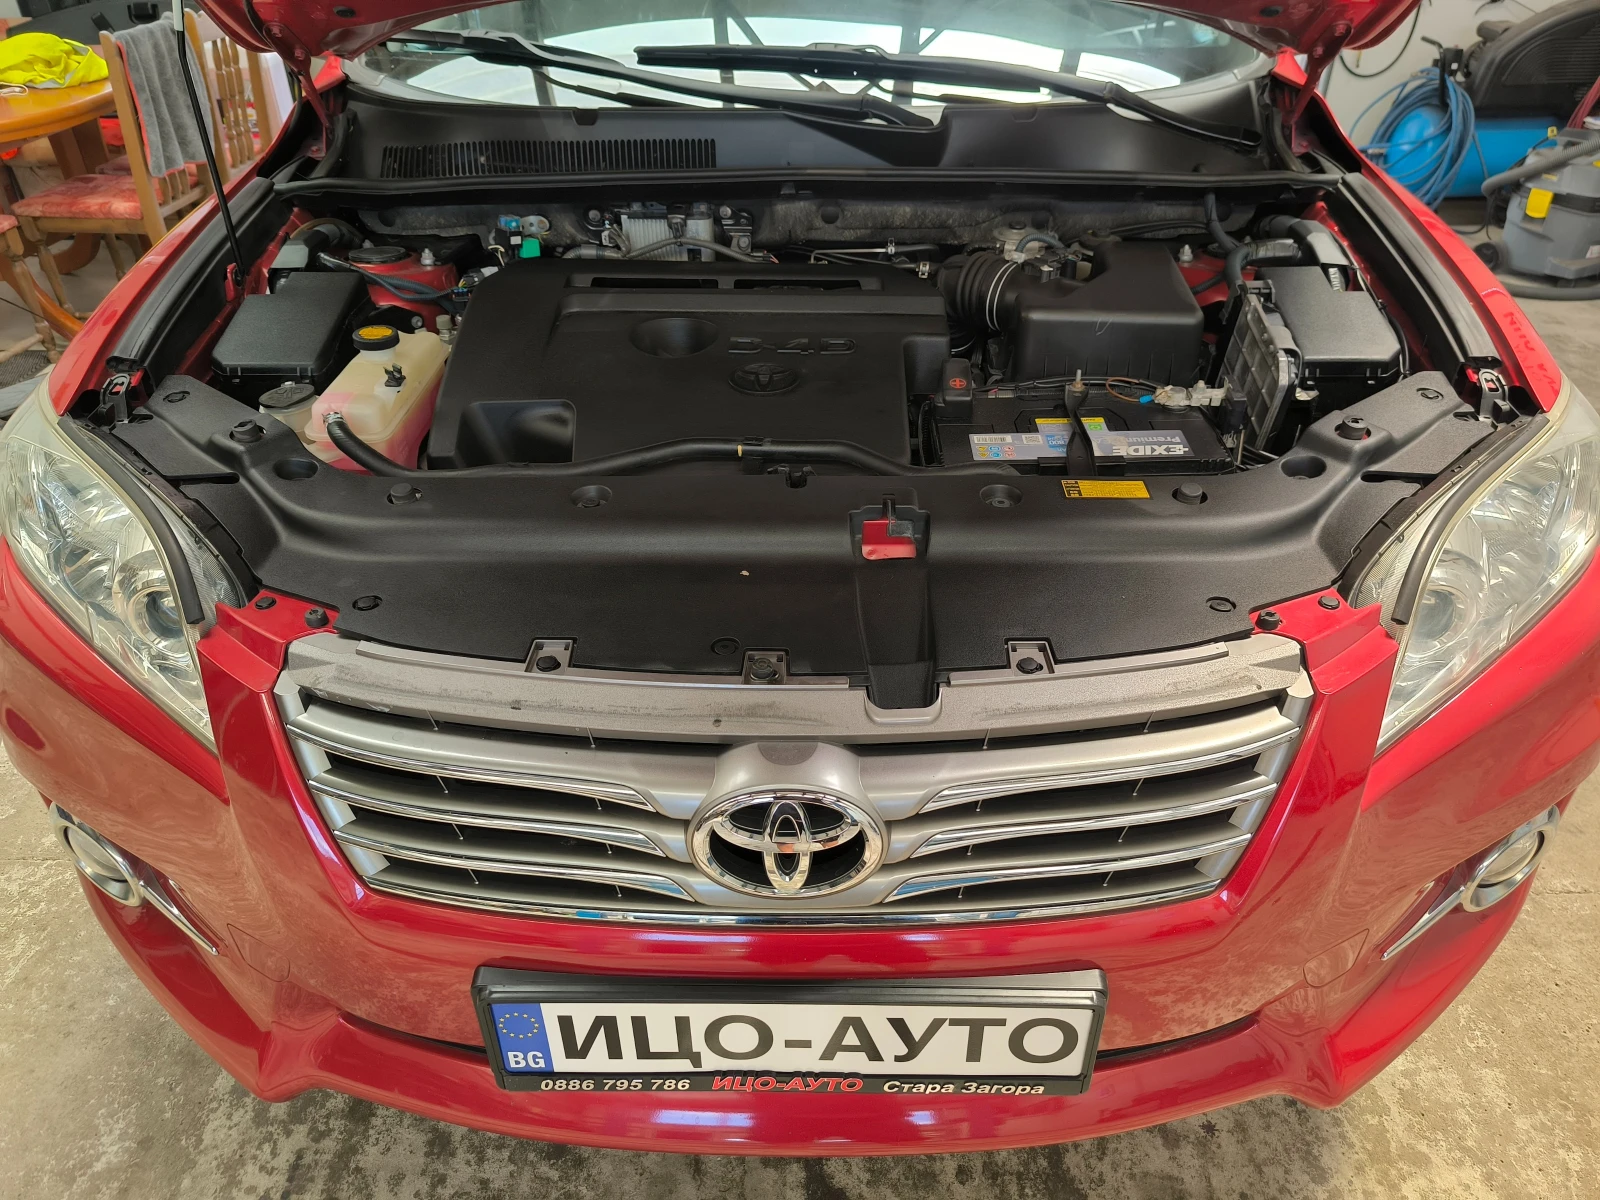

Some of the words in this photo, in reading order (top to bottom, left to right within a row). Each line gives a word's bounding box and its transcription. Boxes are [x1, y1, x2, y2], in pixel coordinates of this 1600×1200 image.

[1112, 444, 1189, 456] EXIDE
[556, 1013, 1079, 1069] ИЦО-АУТО
[507, 1051, 546, 1069] BG
[540, 1079, 595, 1091] 0886
[602, 1079, 643, 1091] 795
[650, 1079, 690, 1091] 786
[711, 1076, 864, 1093] ИЦО-АУТО
[882, 1080, 955, 1094] Стара
[960, 1081, 1045, 1096] Загора
